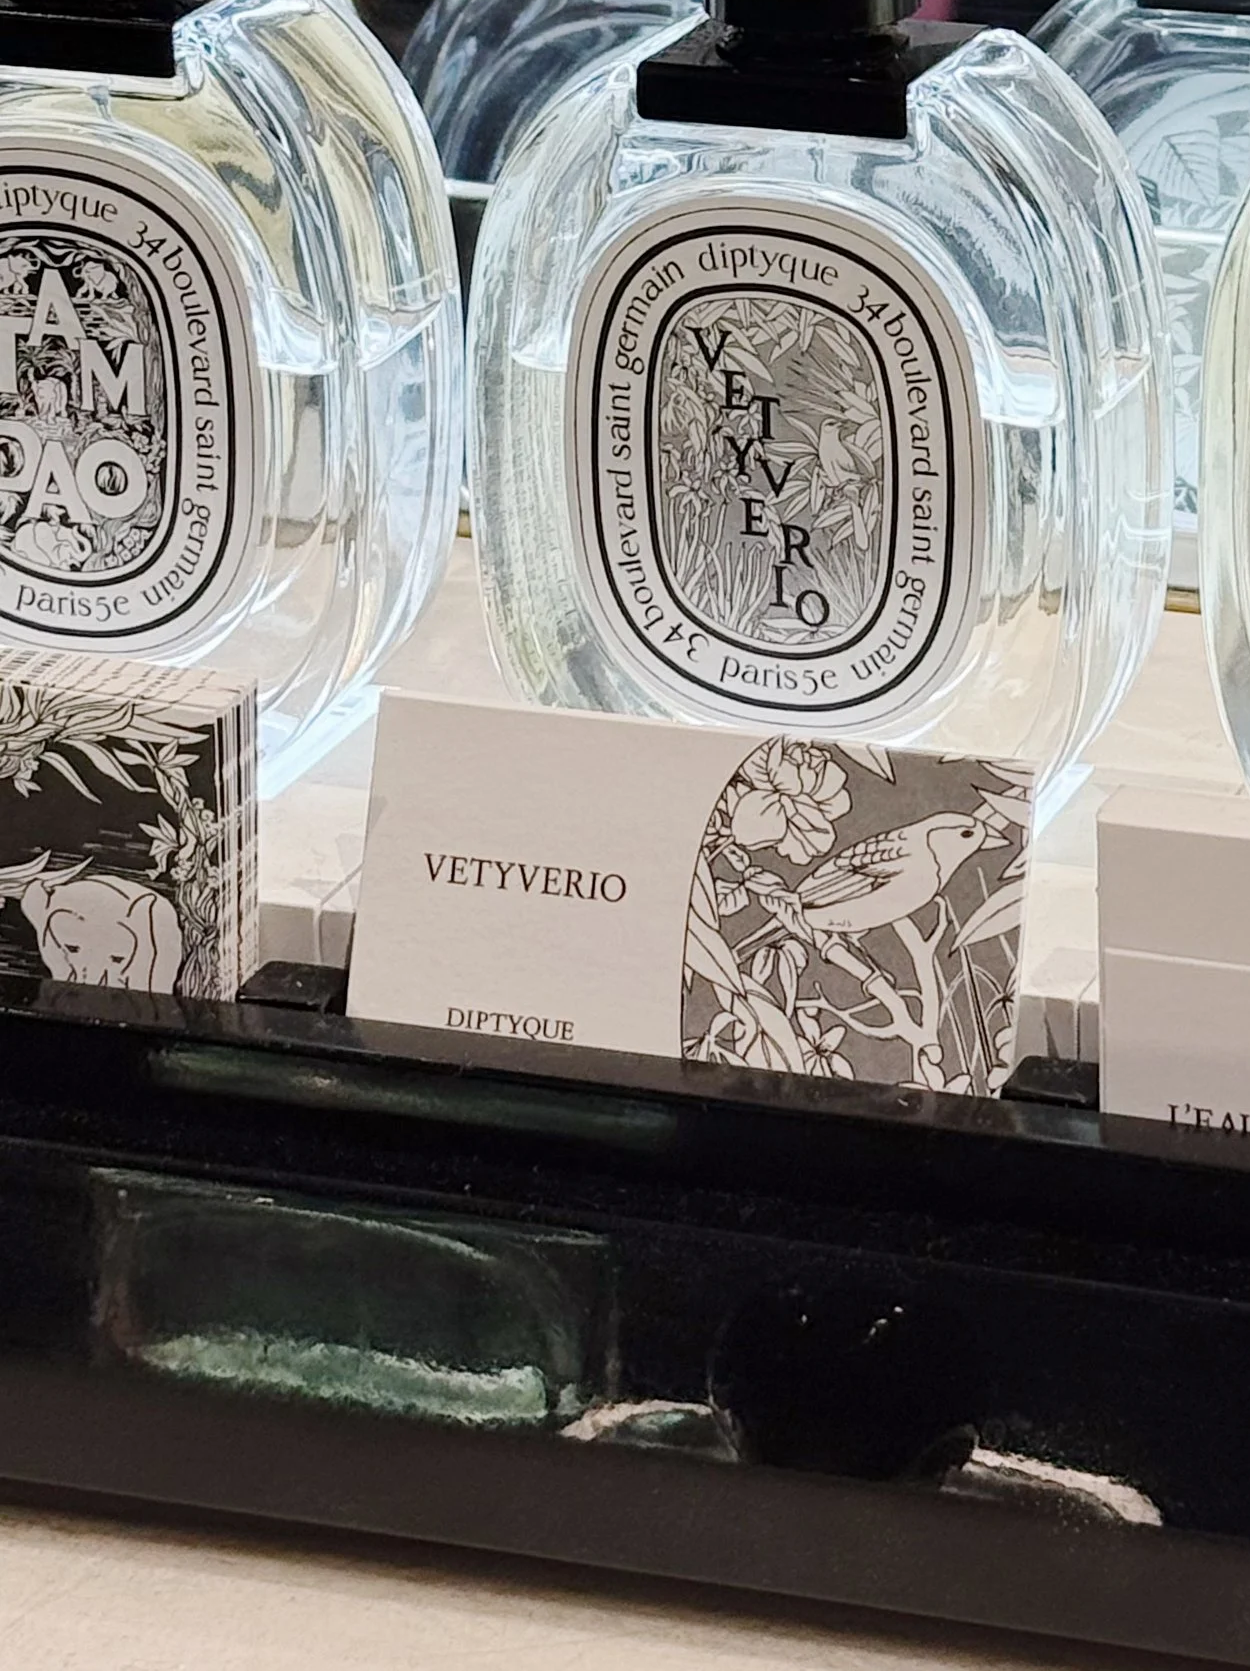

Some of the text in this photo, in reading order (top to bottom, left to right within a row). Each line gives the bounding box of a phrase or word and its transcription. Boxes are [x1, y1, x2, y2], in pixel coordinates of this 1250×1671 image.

[0, 179, 221, 611] iptyque 34 boulevard saint germain
[604, 241, 940, 683] 34 boulevard saint germain diptyque 34 boulevard saint germain
[424, 853, 627, 903] VETYVERIO
[445, 1007, 575, 1041] DIPTYQUE
